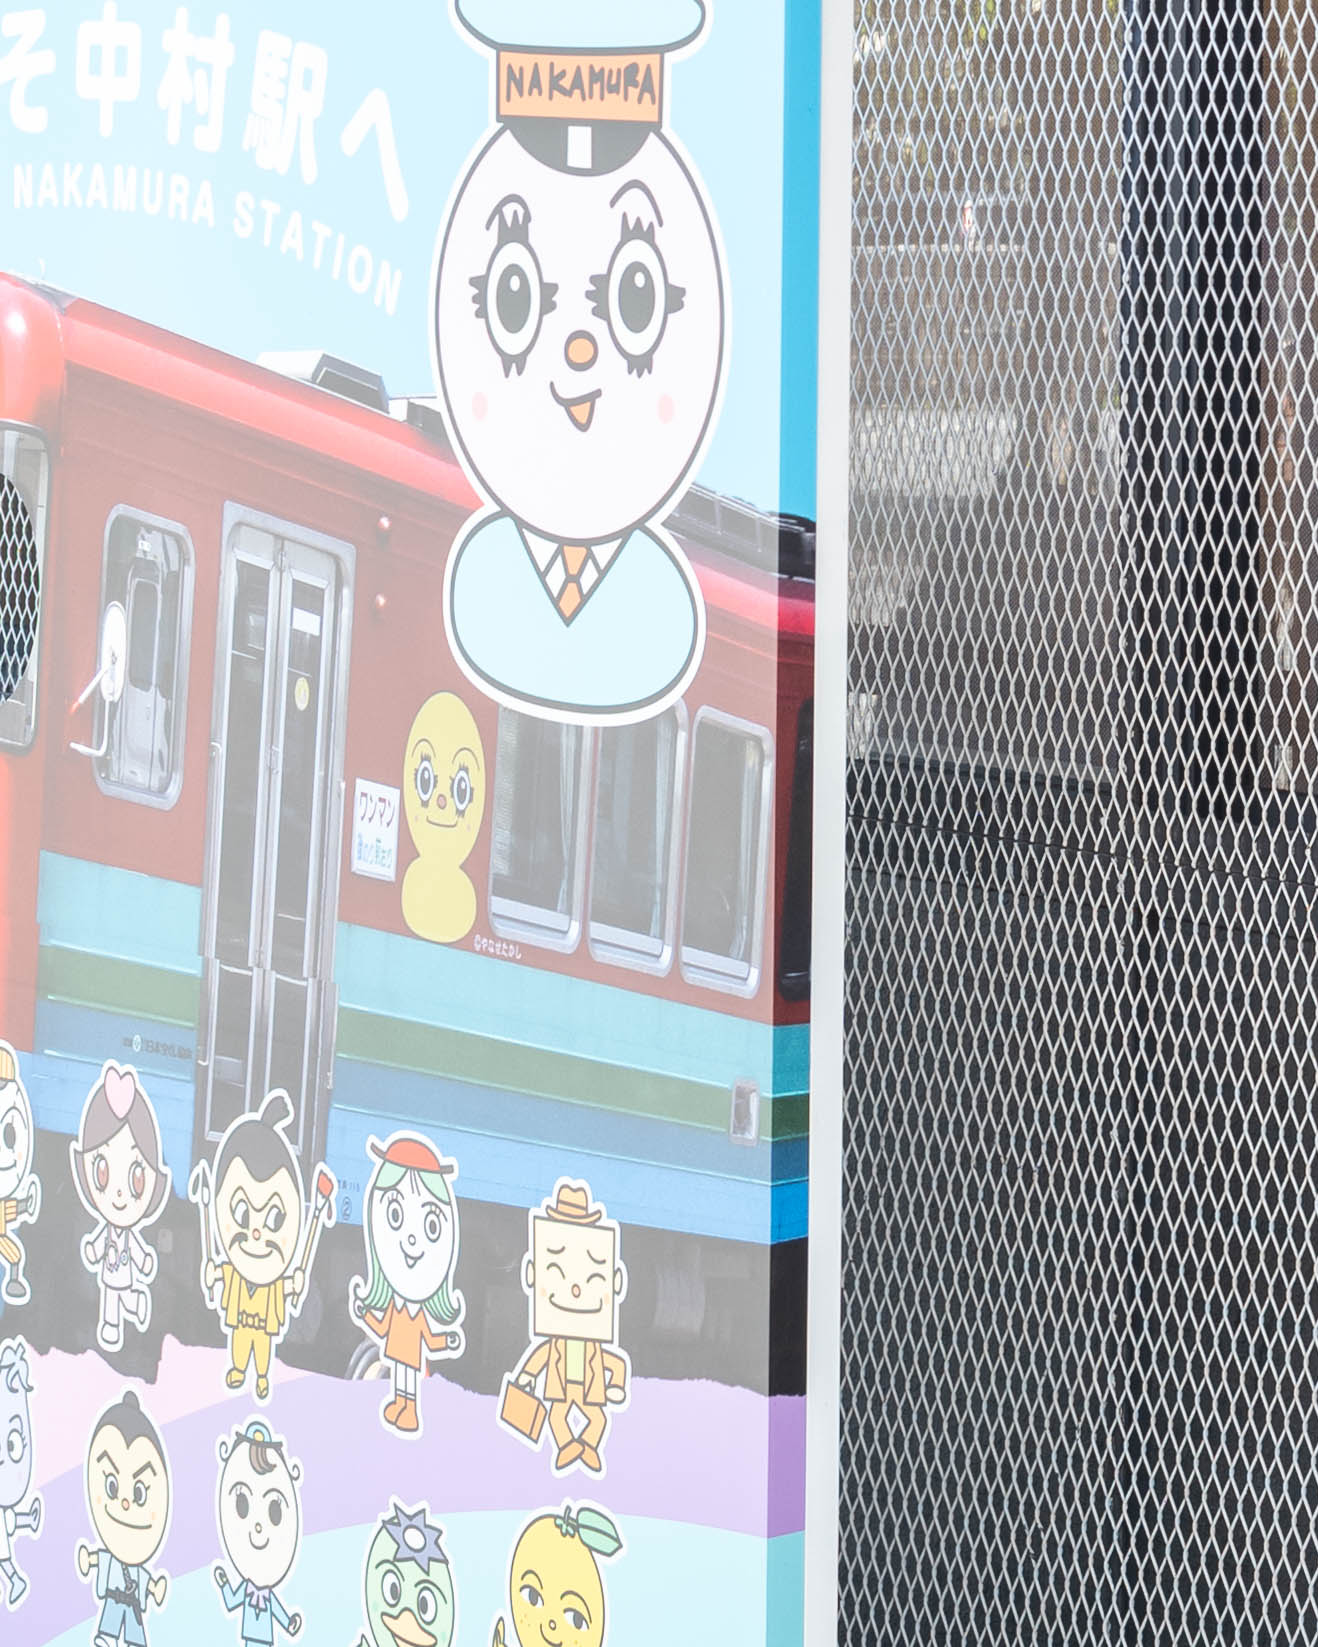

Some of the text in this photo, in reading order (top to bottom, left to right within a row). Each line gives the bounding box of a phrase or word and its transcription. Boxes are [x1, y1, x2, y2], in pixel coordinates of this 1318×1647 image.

[505, 61, 656, 105] NAKAMURA
[13, 162, 402, 316] NAKAMURA STATION
[360, 791, 396, 828] ワンマン
